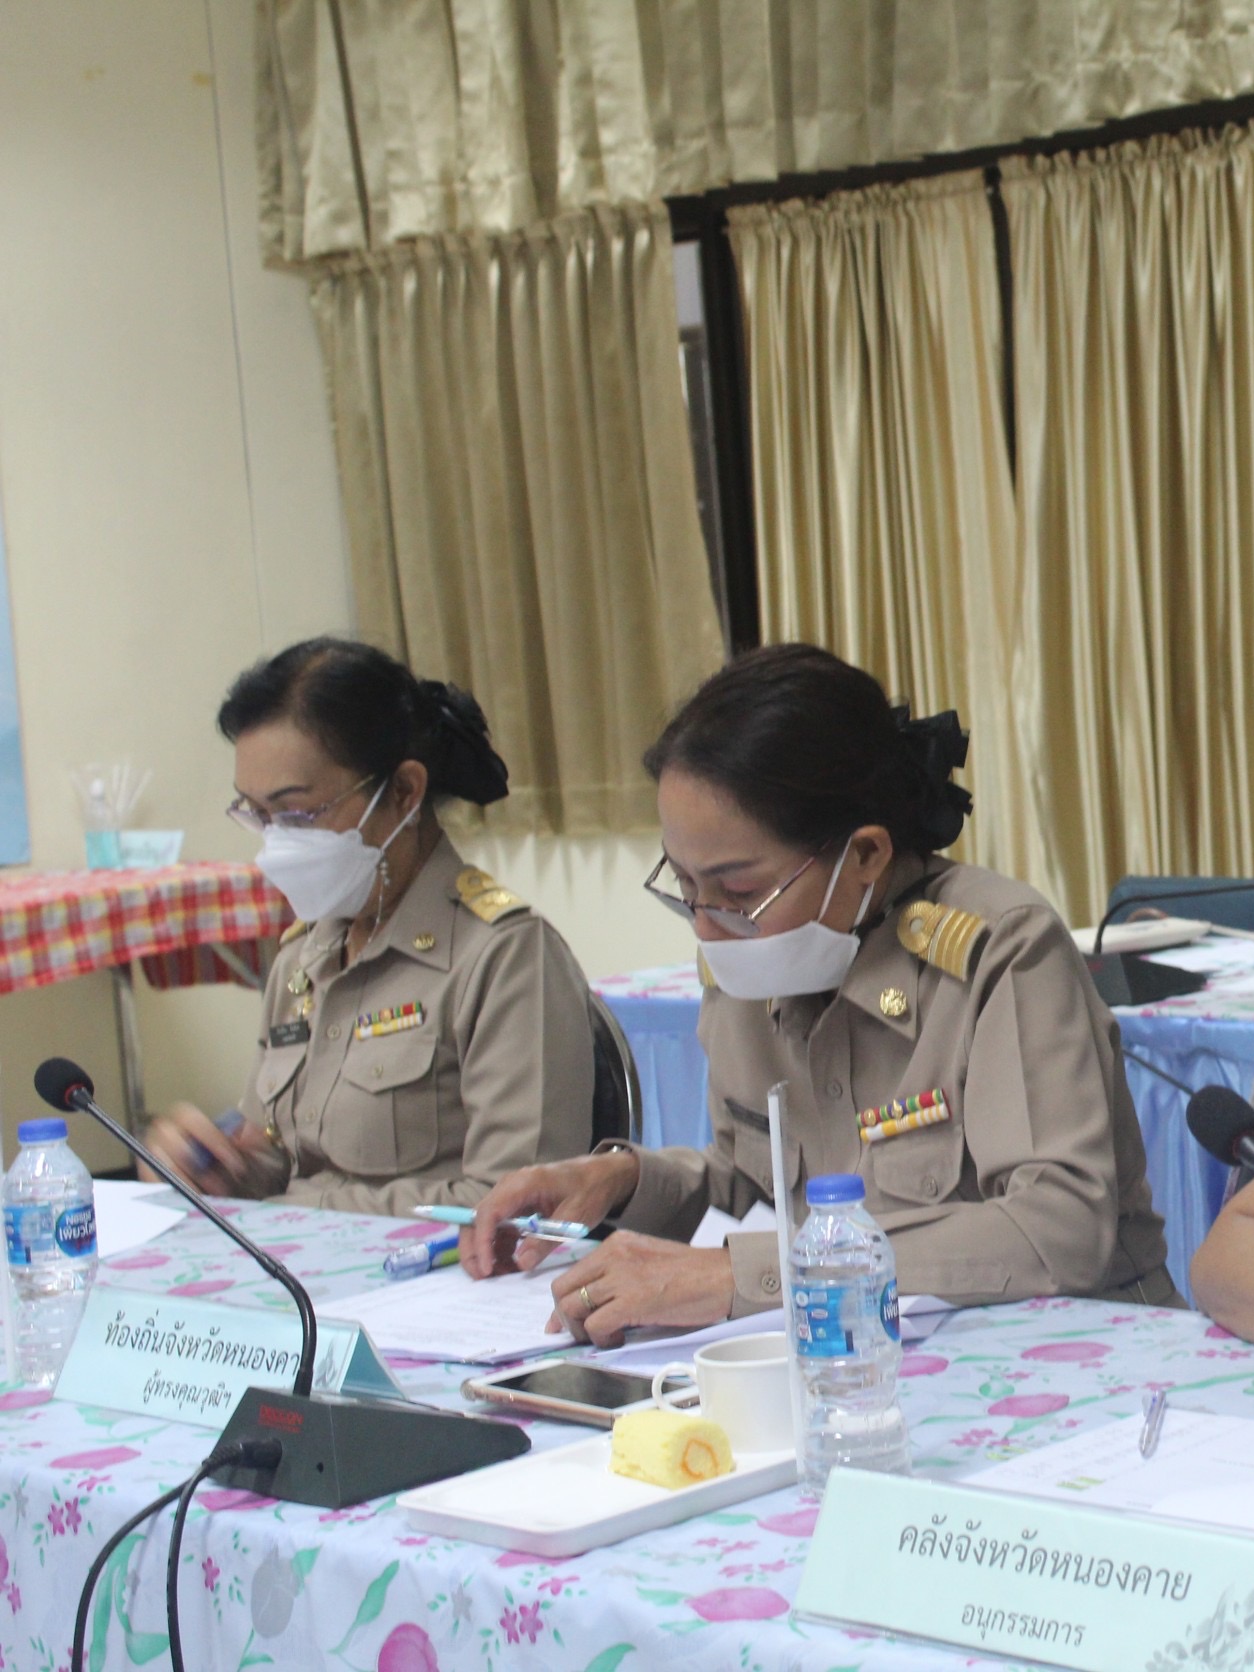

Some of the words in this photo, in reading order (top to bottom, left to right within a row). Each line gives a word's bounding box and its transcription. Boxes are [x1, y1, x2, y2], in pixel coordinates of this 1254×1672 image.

[104, 1309, 301, 1377] ท้องถิ่นจังหวัดหนองคา
[143, 1369, 232, 1414] ผู้ทรงคุณวุฒิฯ
[897, 1514, 1192, 1601] คลังจังหวัดหนองคาย
[960, 1601, 1086, 1647] อนุกรรมการ
